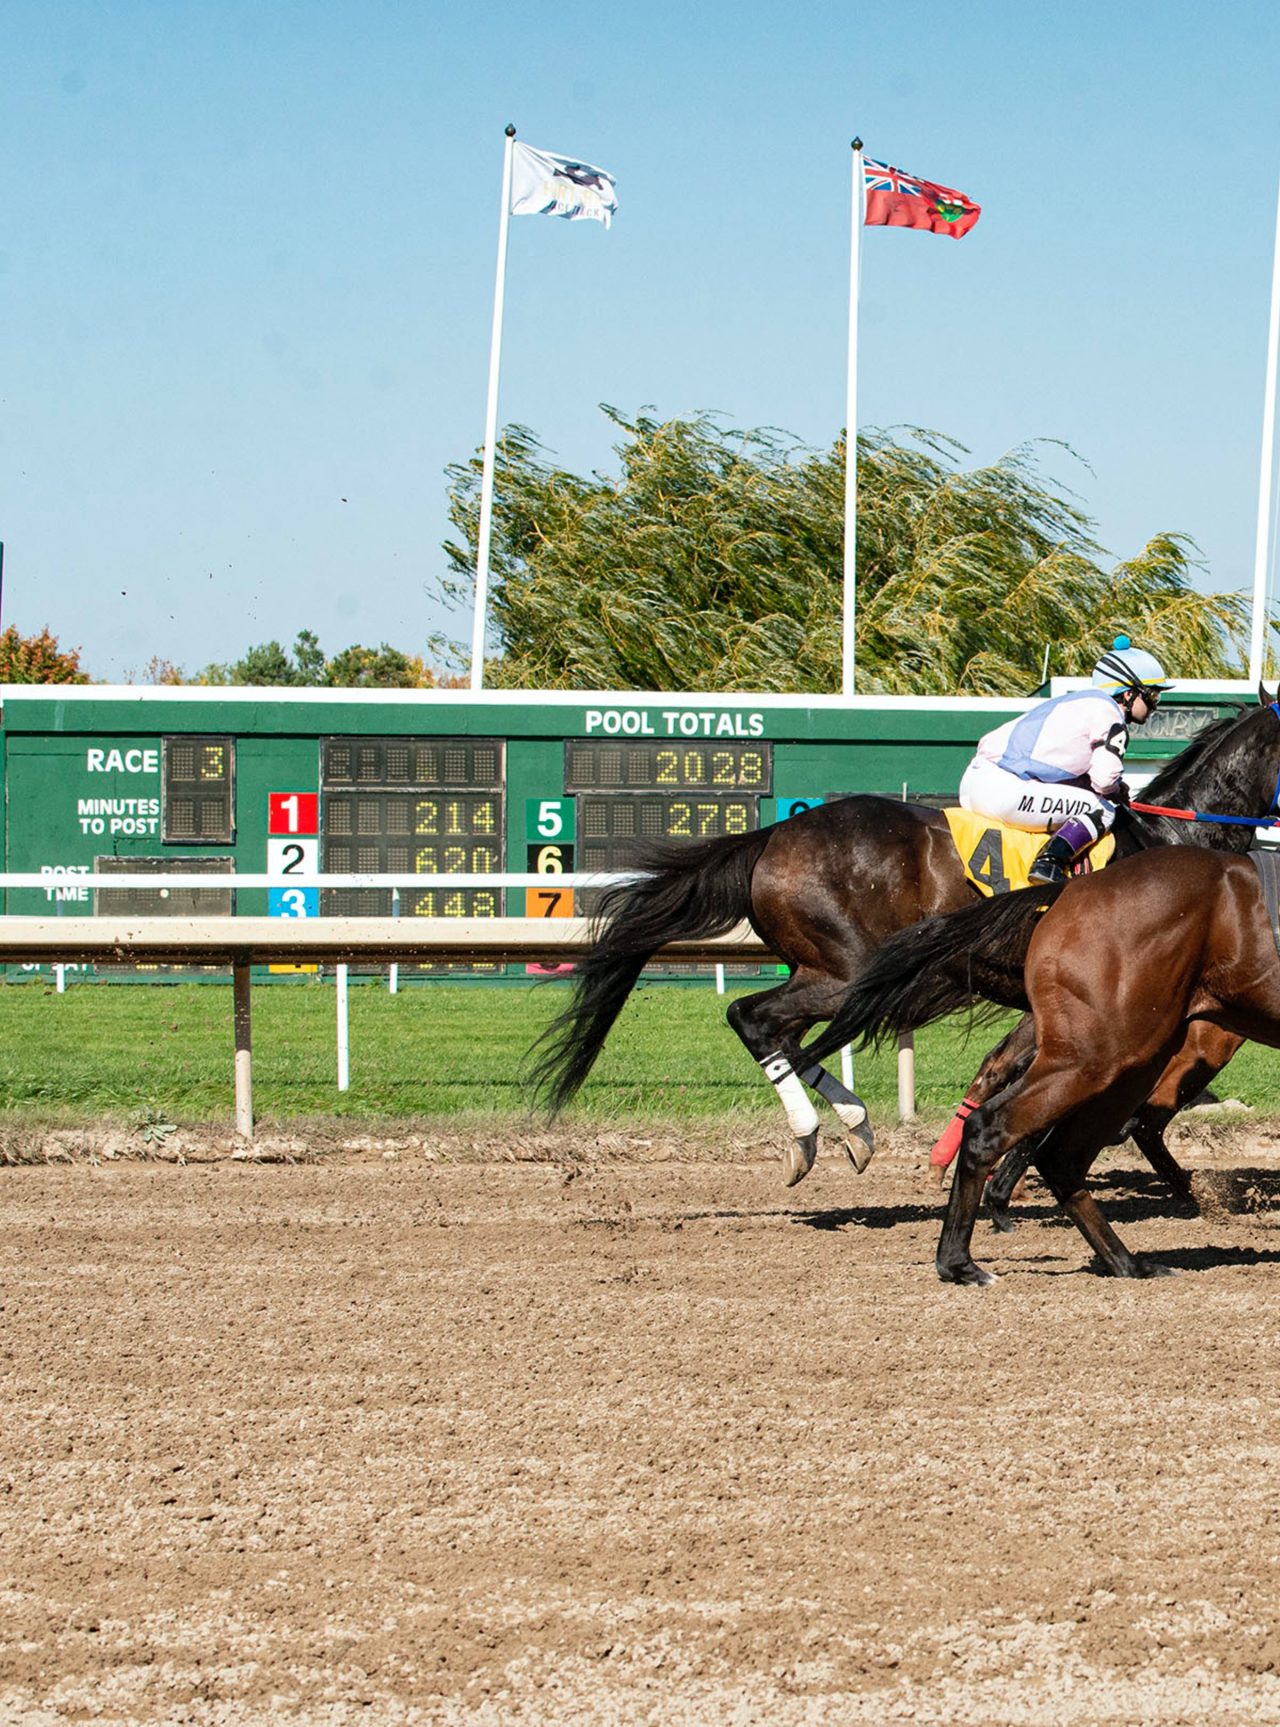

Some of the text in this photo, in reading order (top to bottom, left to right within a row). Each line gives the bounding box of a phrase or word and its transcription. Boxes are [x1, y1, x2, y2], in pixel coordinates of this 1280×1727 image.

[586, 711, 764, 736] POOL TOTALS
[86, 749, 158, 772] RACE
[201, 746, 224, 778] 3
[656, 751, 762, 784] 2028
[77, 799, 160, 815] MINUTES
[280, 795, 299, 832] 1
[1018, 795, 1034, 813] M.
[80, 818, 159, 834] TO POST
[415, 802, 495, 834] 214
[537, 801, 562, 836] 5
[668, 804, 747, 834] 278
[281, 845, 305, 874] 2
[415, 847, 493, 873] 620
[538, 846, 563, 873] 6
[968, 829, 1010, 895] 4
[281, 890, 306, 917] 3
[538, 893, 561, 917] 7
